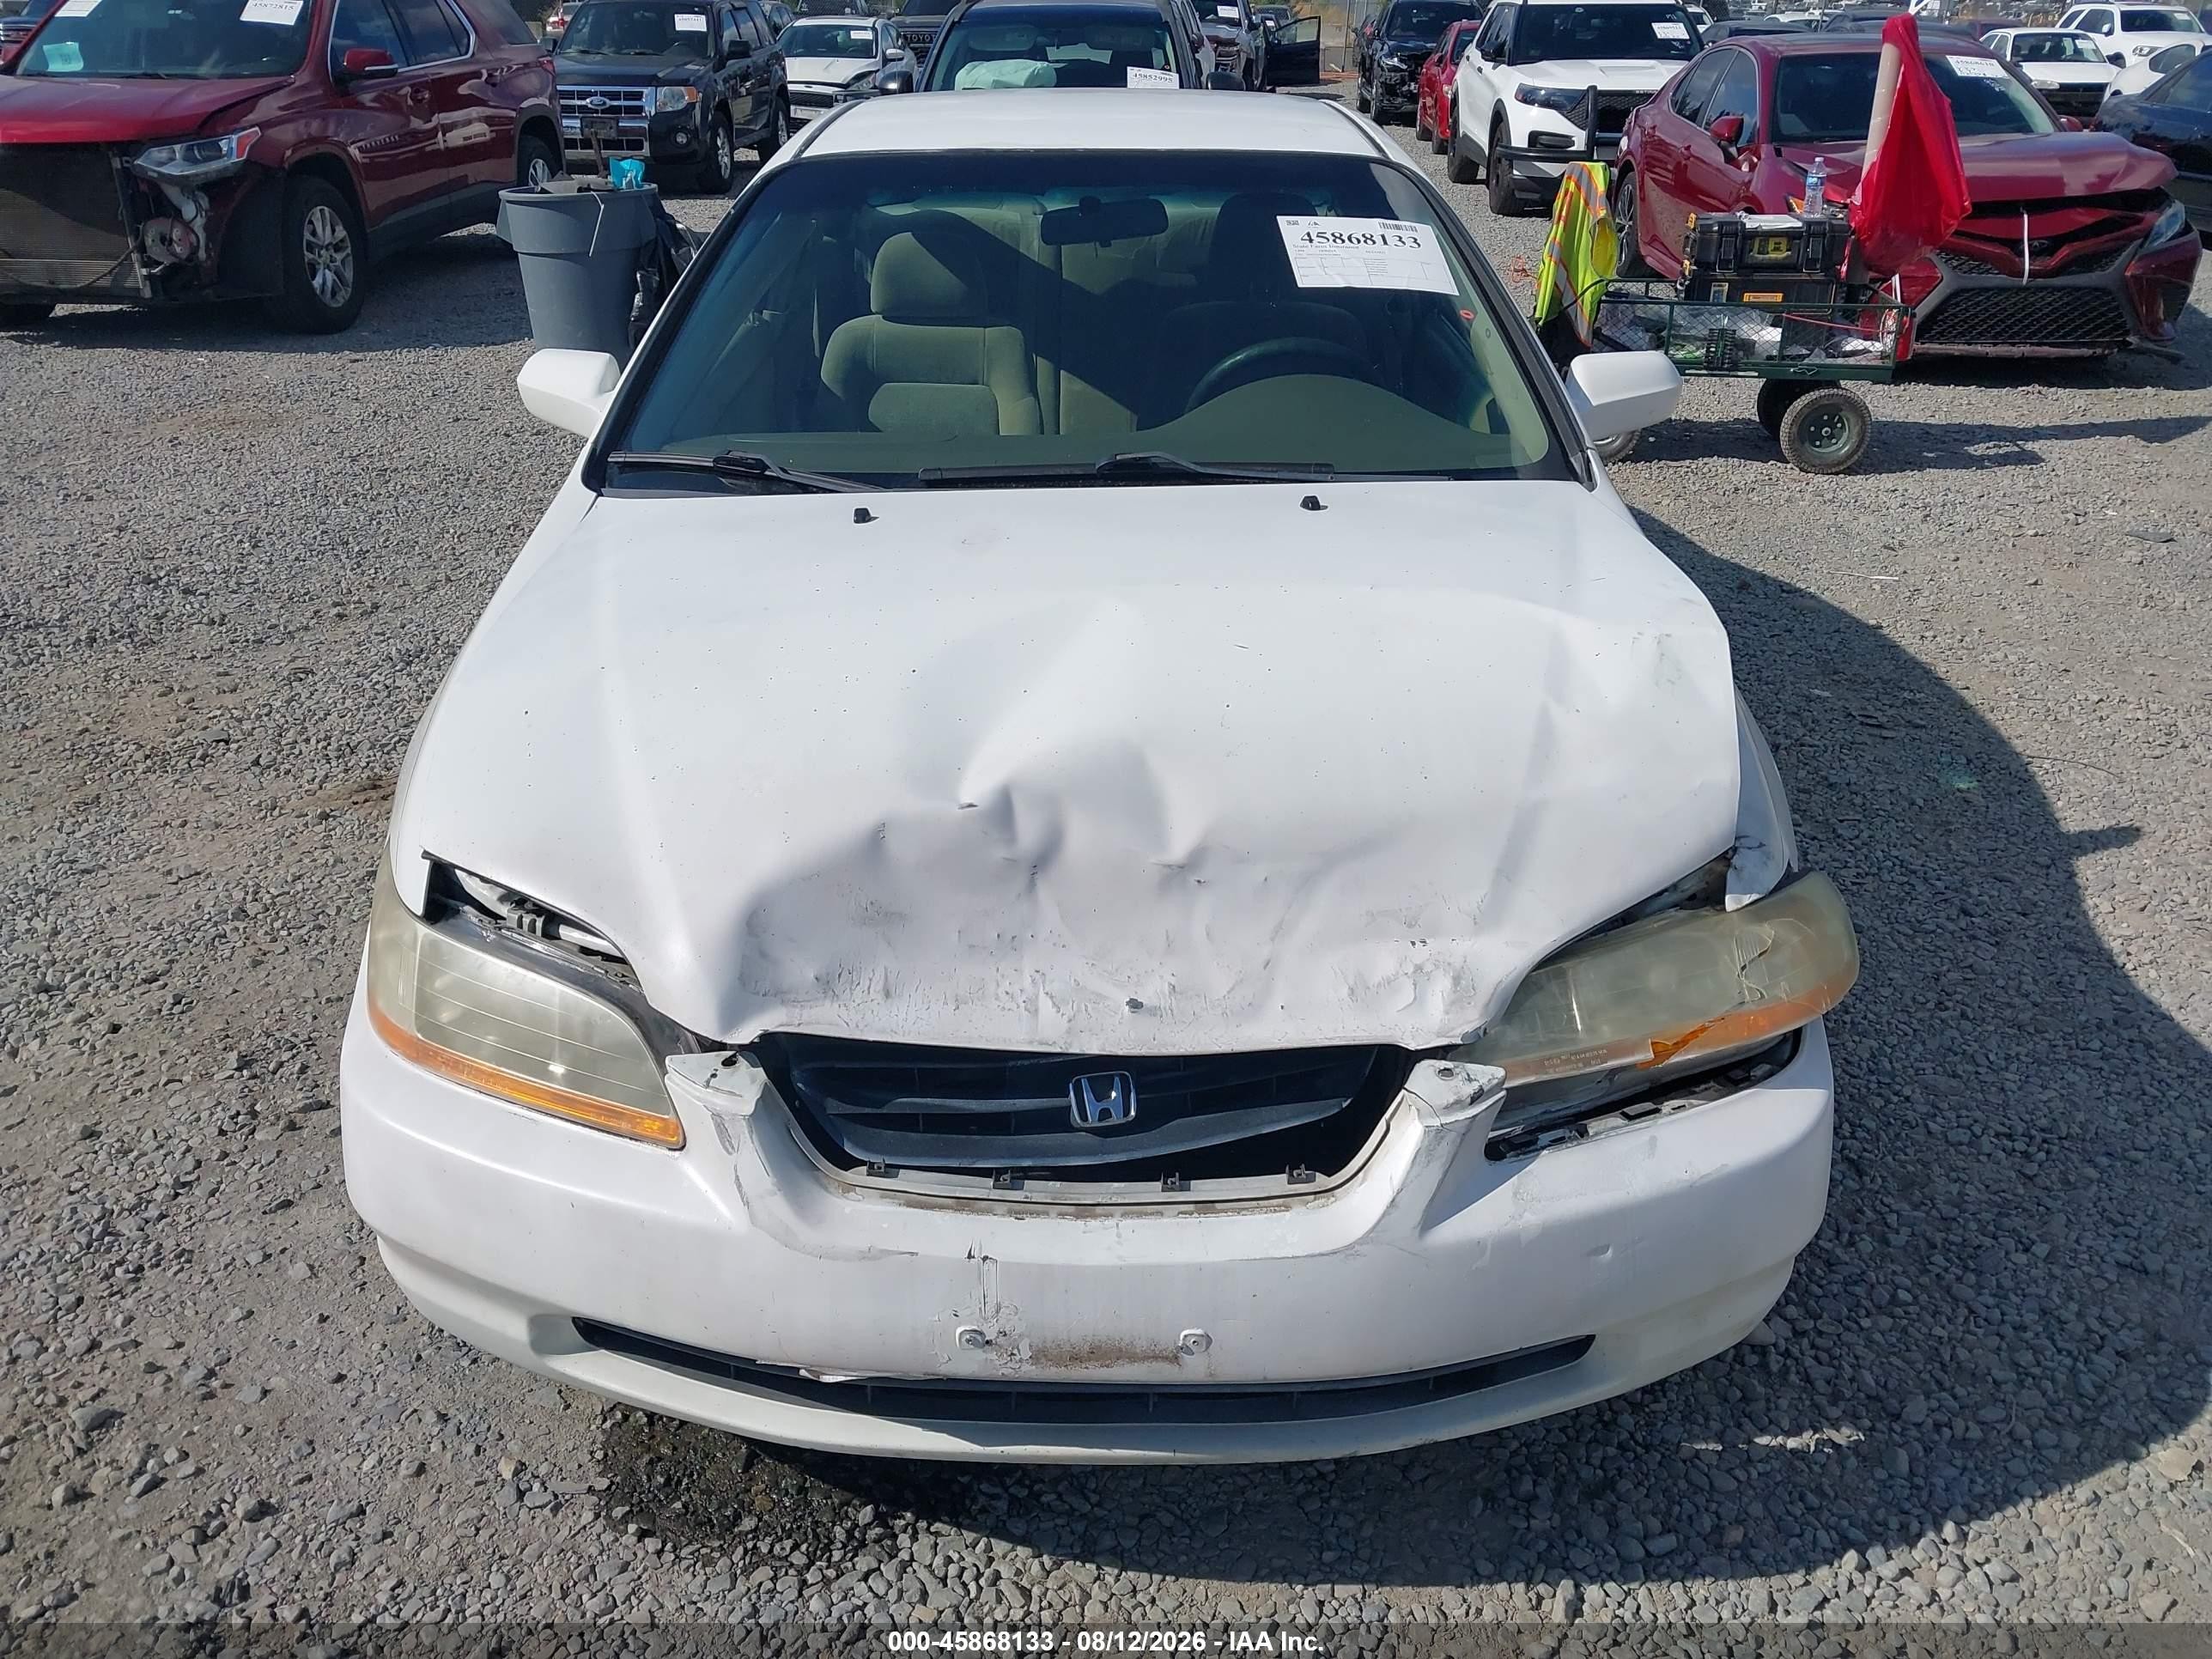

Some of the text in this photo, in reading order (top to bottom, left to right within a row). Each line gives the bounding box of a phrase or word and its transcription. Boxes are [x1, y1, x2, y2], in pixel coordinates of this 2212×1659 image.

[907, 33, 936, 42] TOYOT
[1133, 72, 1173, 83] 45852995
[1300, 231, 1421, 249] 45868133
